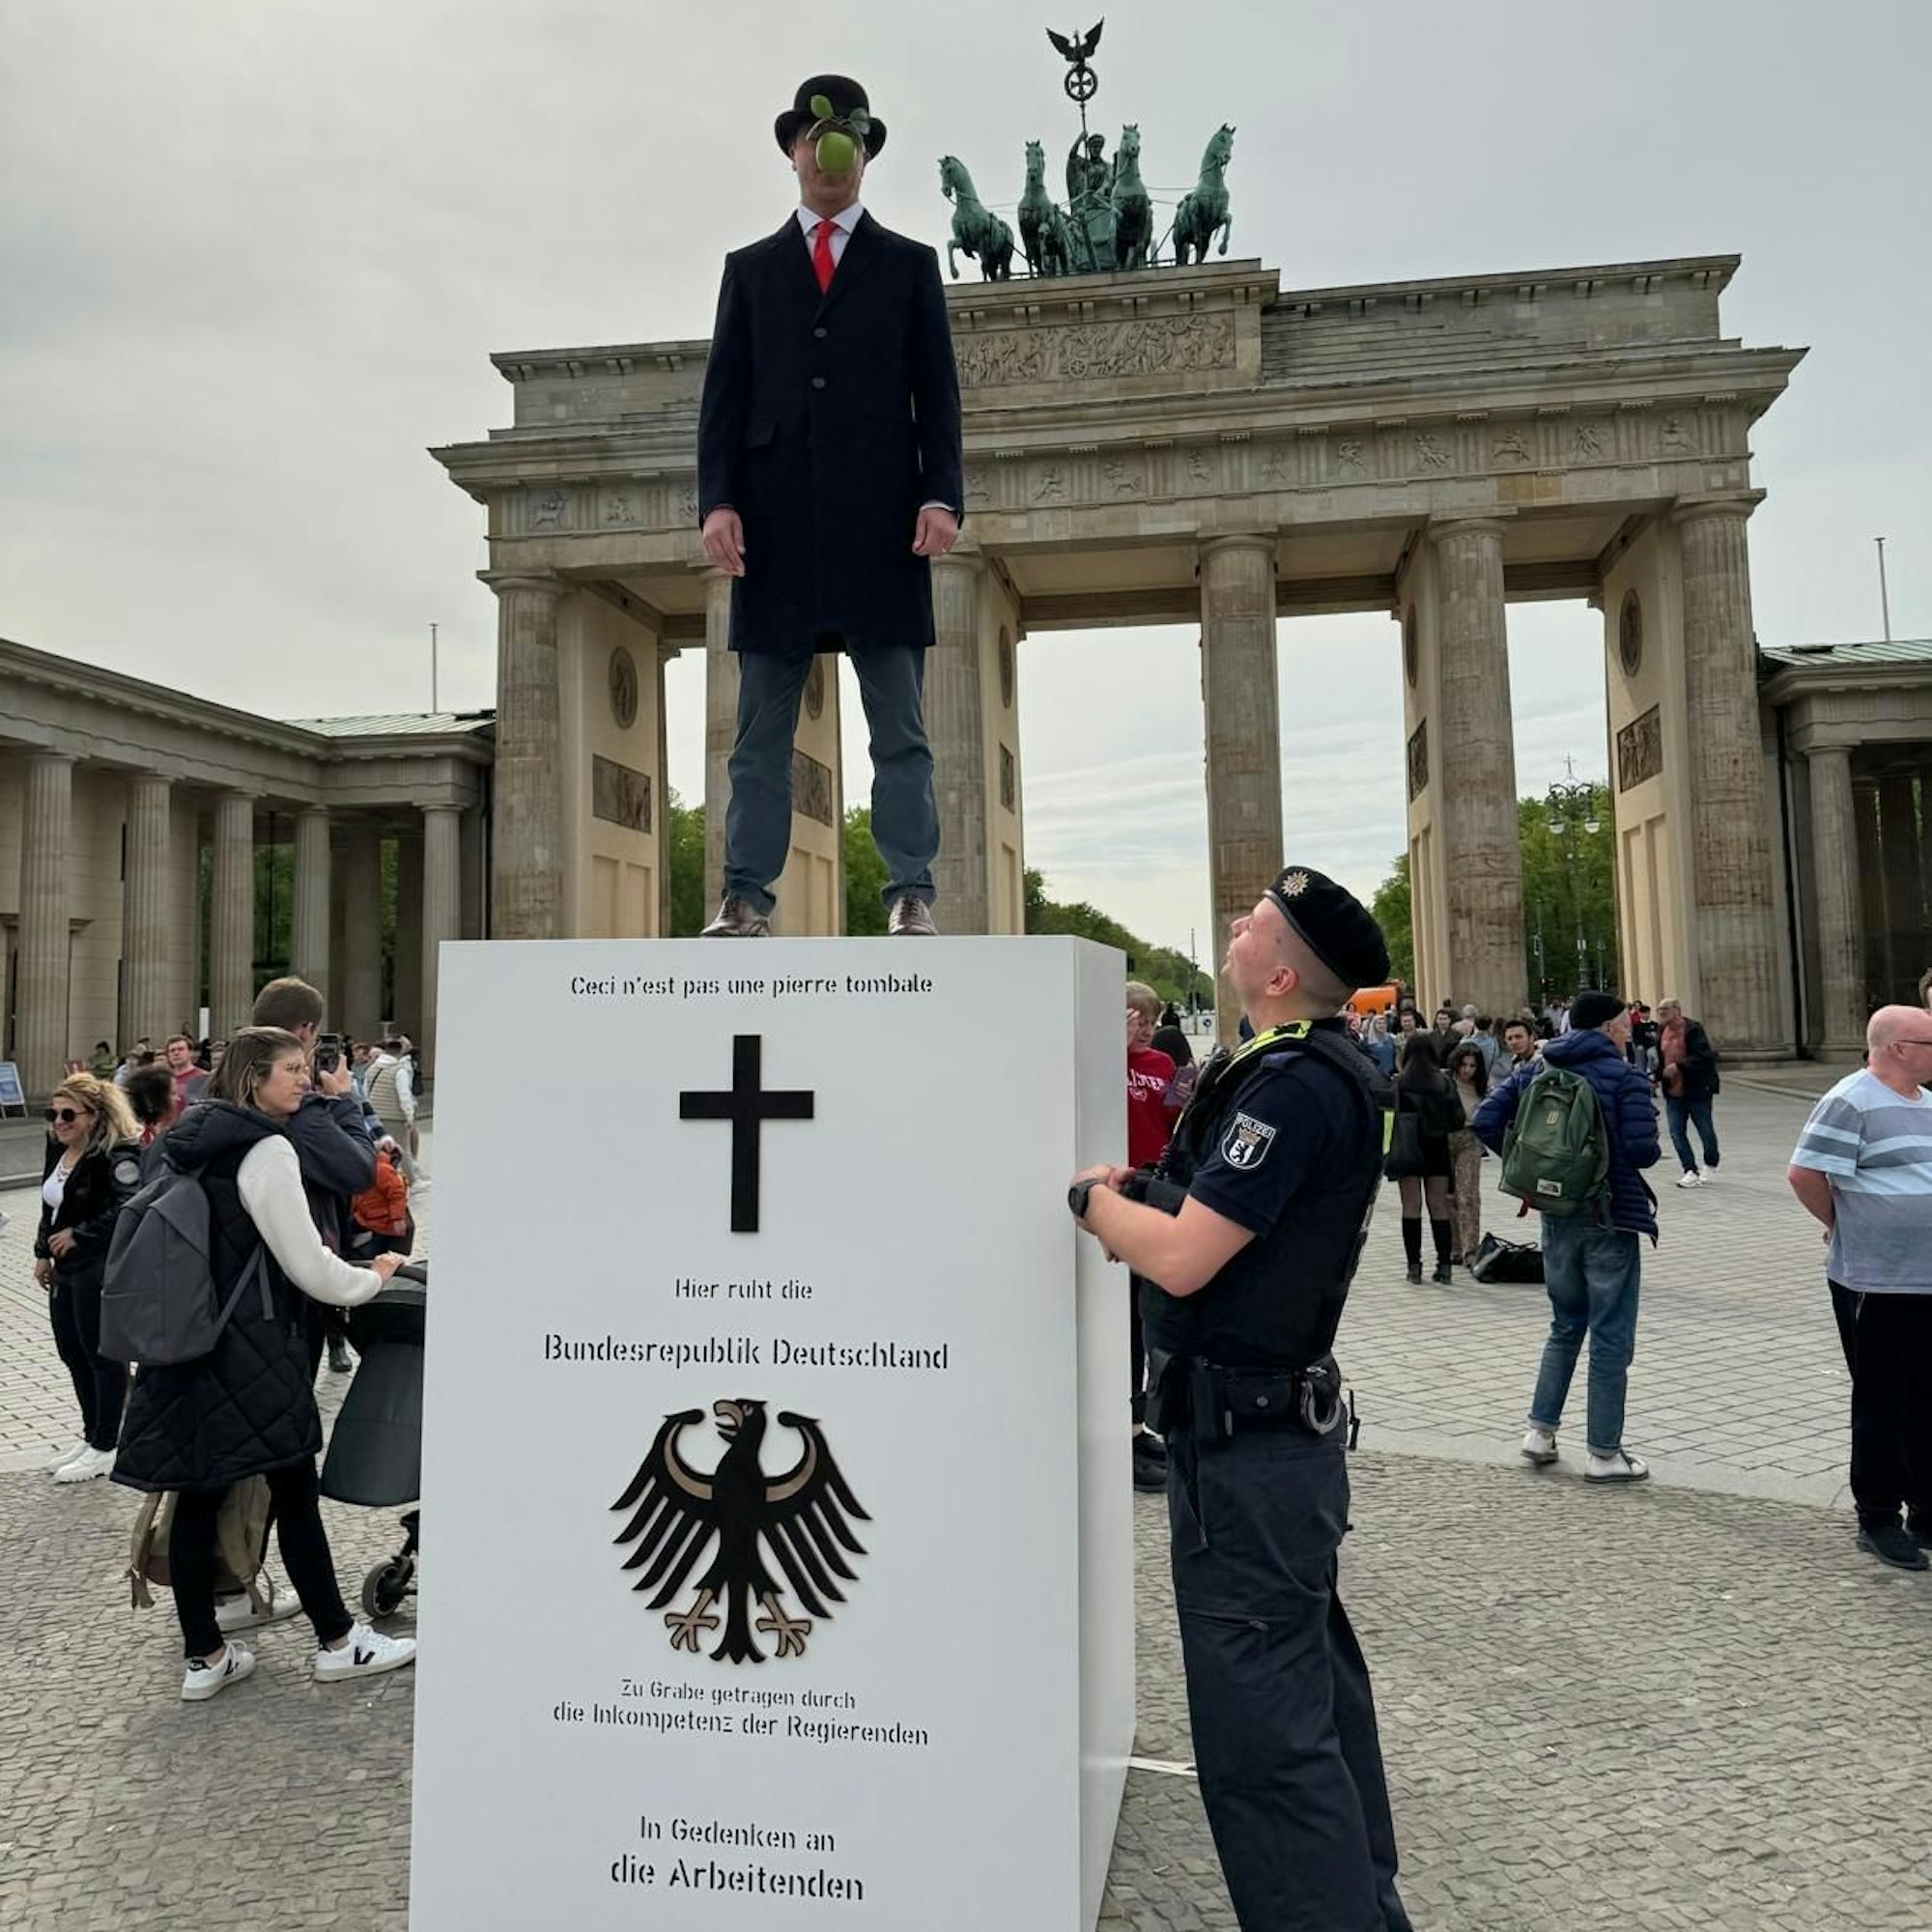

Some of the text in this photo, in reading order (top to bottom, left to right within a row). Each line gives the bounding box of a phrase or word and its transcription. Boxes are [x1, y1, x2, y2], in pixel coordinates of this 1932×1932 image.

[571, 975, 615, 995] Ceci
[683, 980, 720, 1000] pas
[727, 980, 765, 995] une
[772, 975, 838, 999] pierre
[846, 973, 933, 993] tombale
[1236, 1114, 1272, 1139] POLIZEI
[675, 1278, 812, 1300] Hier ruht die
[545, 1333, 948, 1370] Bundesrepublik Deutschland
[621, 1678, 856, 1710] Zu Grabe getragen durch
[553, 1701, 928, 1746] die Inkompetenz der Regierenden
[640, 1815, 835, 1853] In Gedenken an
[611, 1853, 864, 1901] die Arbeitenden
